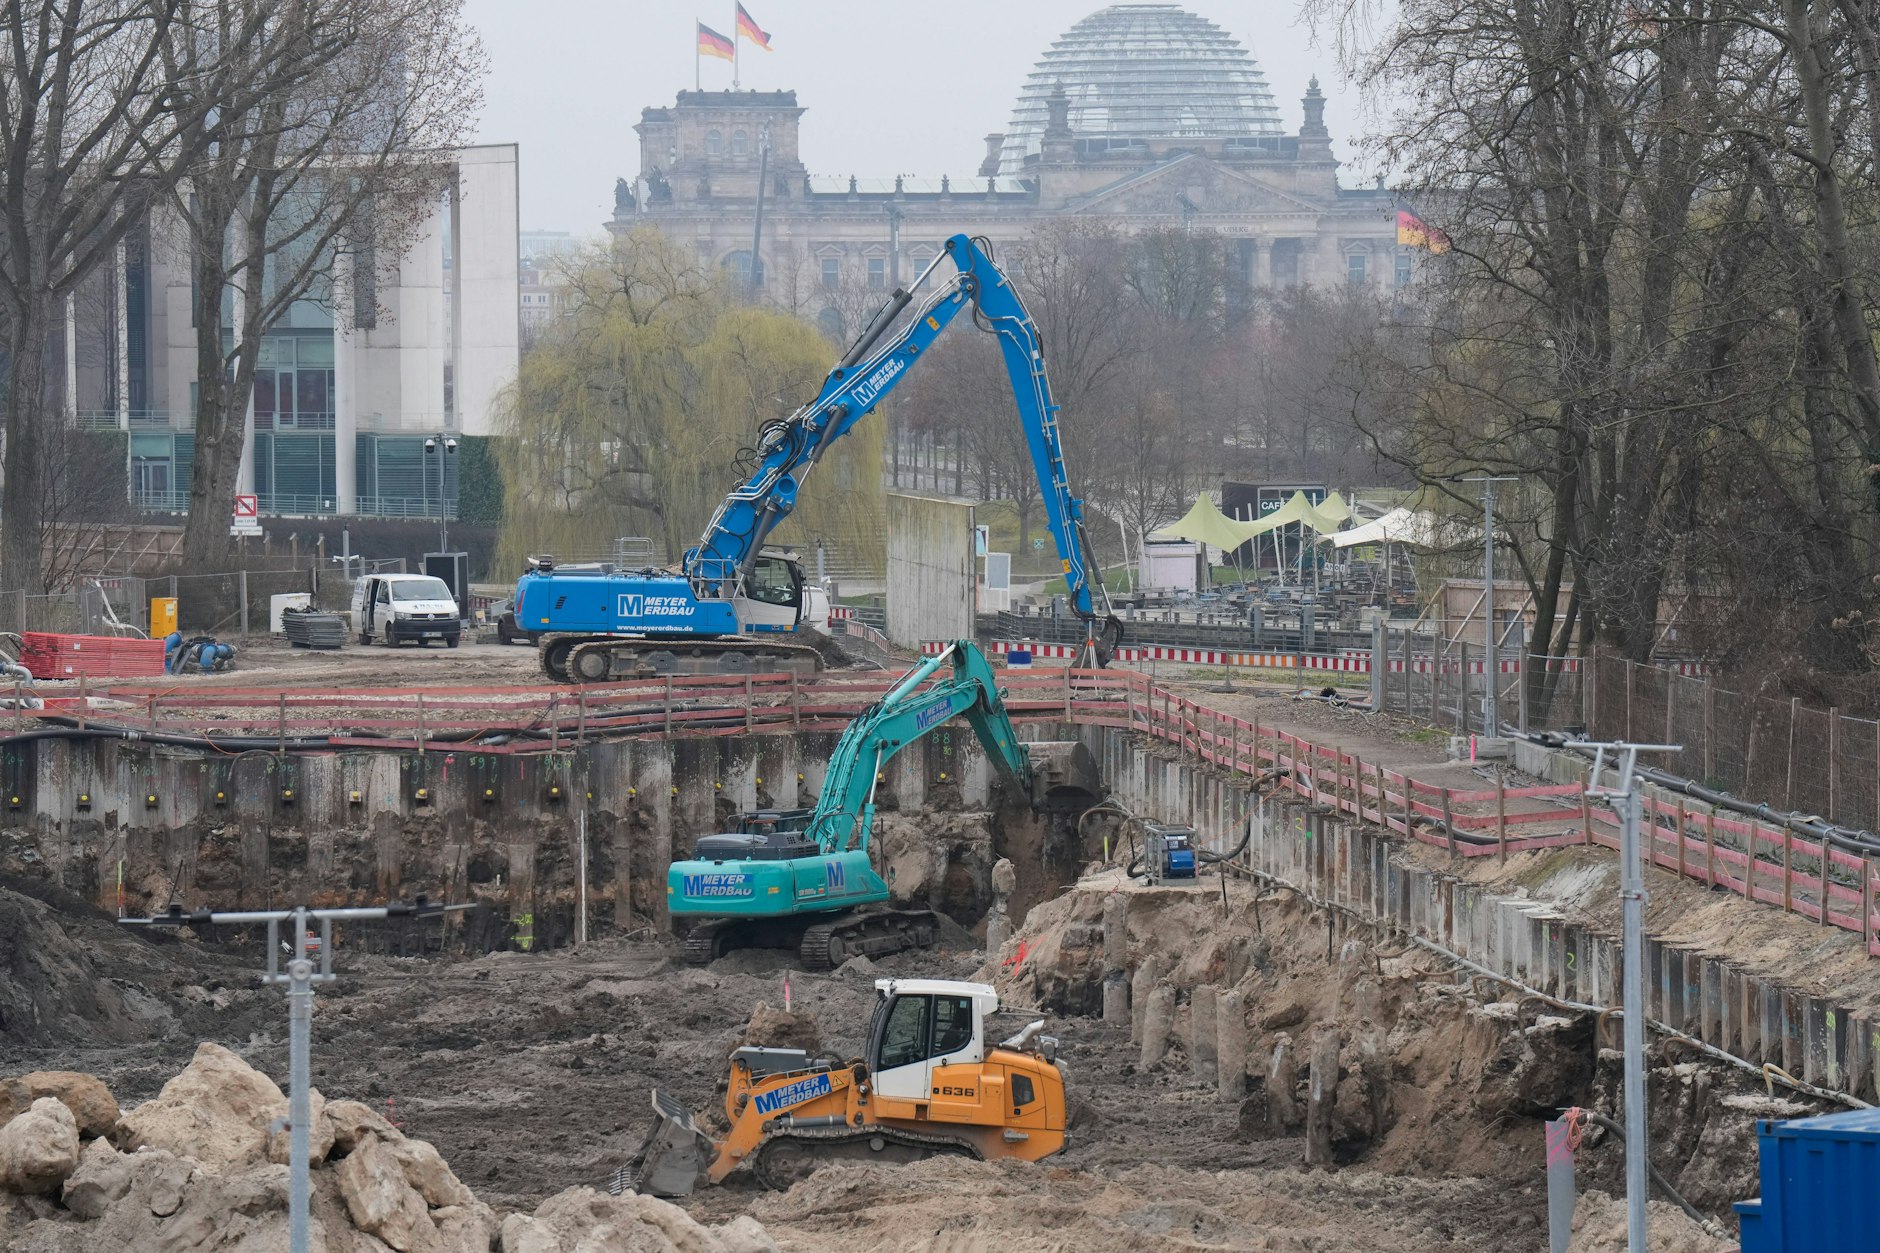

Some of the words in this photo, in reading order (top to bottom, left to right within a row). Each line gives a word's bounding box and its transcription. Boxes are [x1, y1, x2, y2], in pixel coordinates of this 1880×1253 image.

[869, 358, 896, 386] MEYER
[874, 360, 905, 391] ERDBAU
[1261, 501, 1285, 511] CAF
[644, 597, 687, 606] MEYER
[644, 606, 695, 616] ERDBAU
[702, 874, 746, 885] MEYER
[702, 886, 752, 896] ERDBAU
[777, 1077, 820, 1099] MEYER
[943, 1086, 975, 1097] 636
[780, 1083, 830, 1108] ERDBAU
